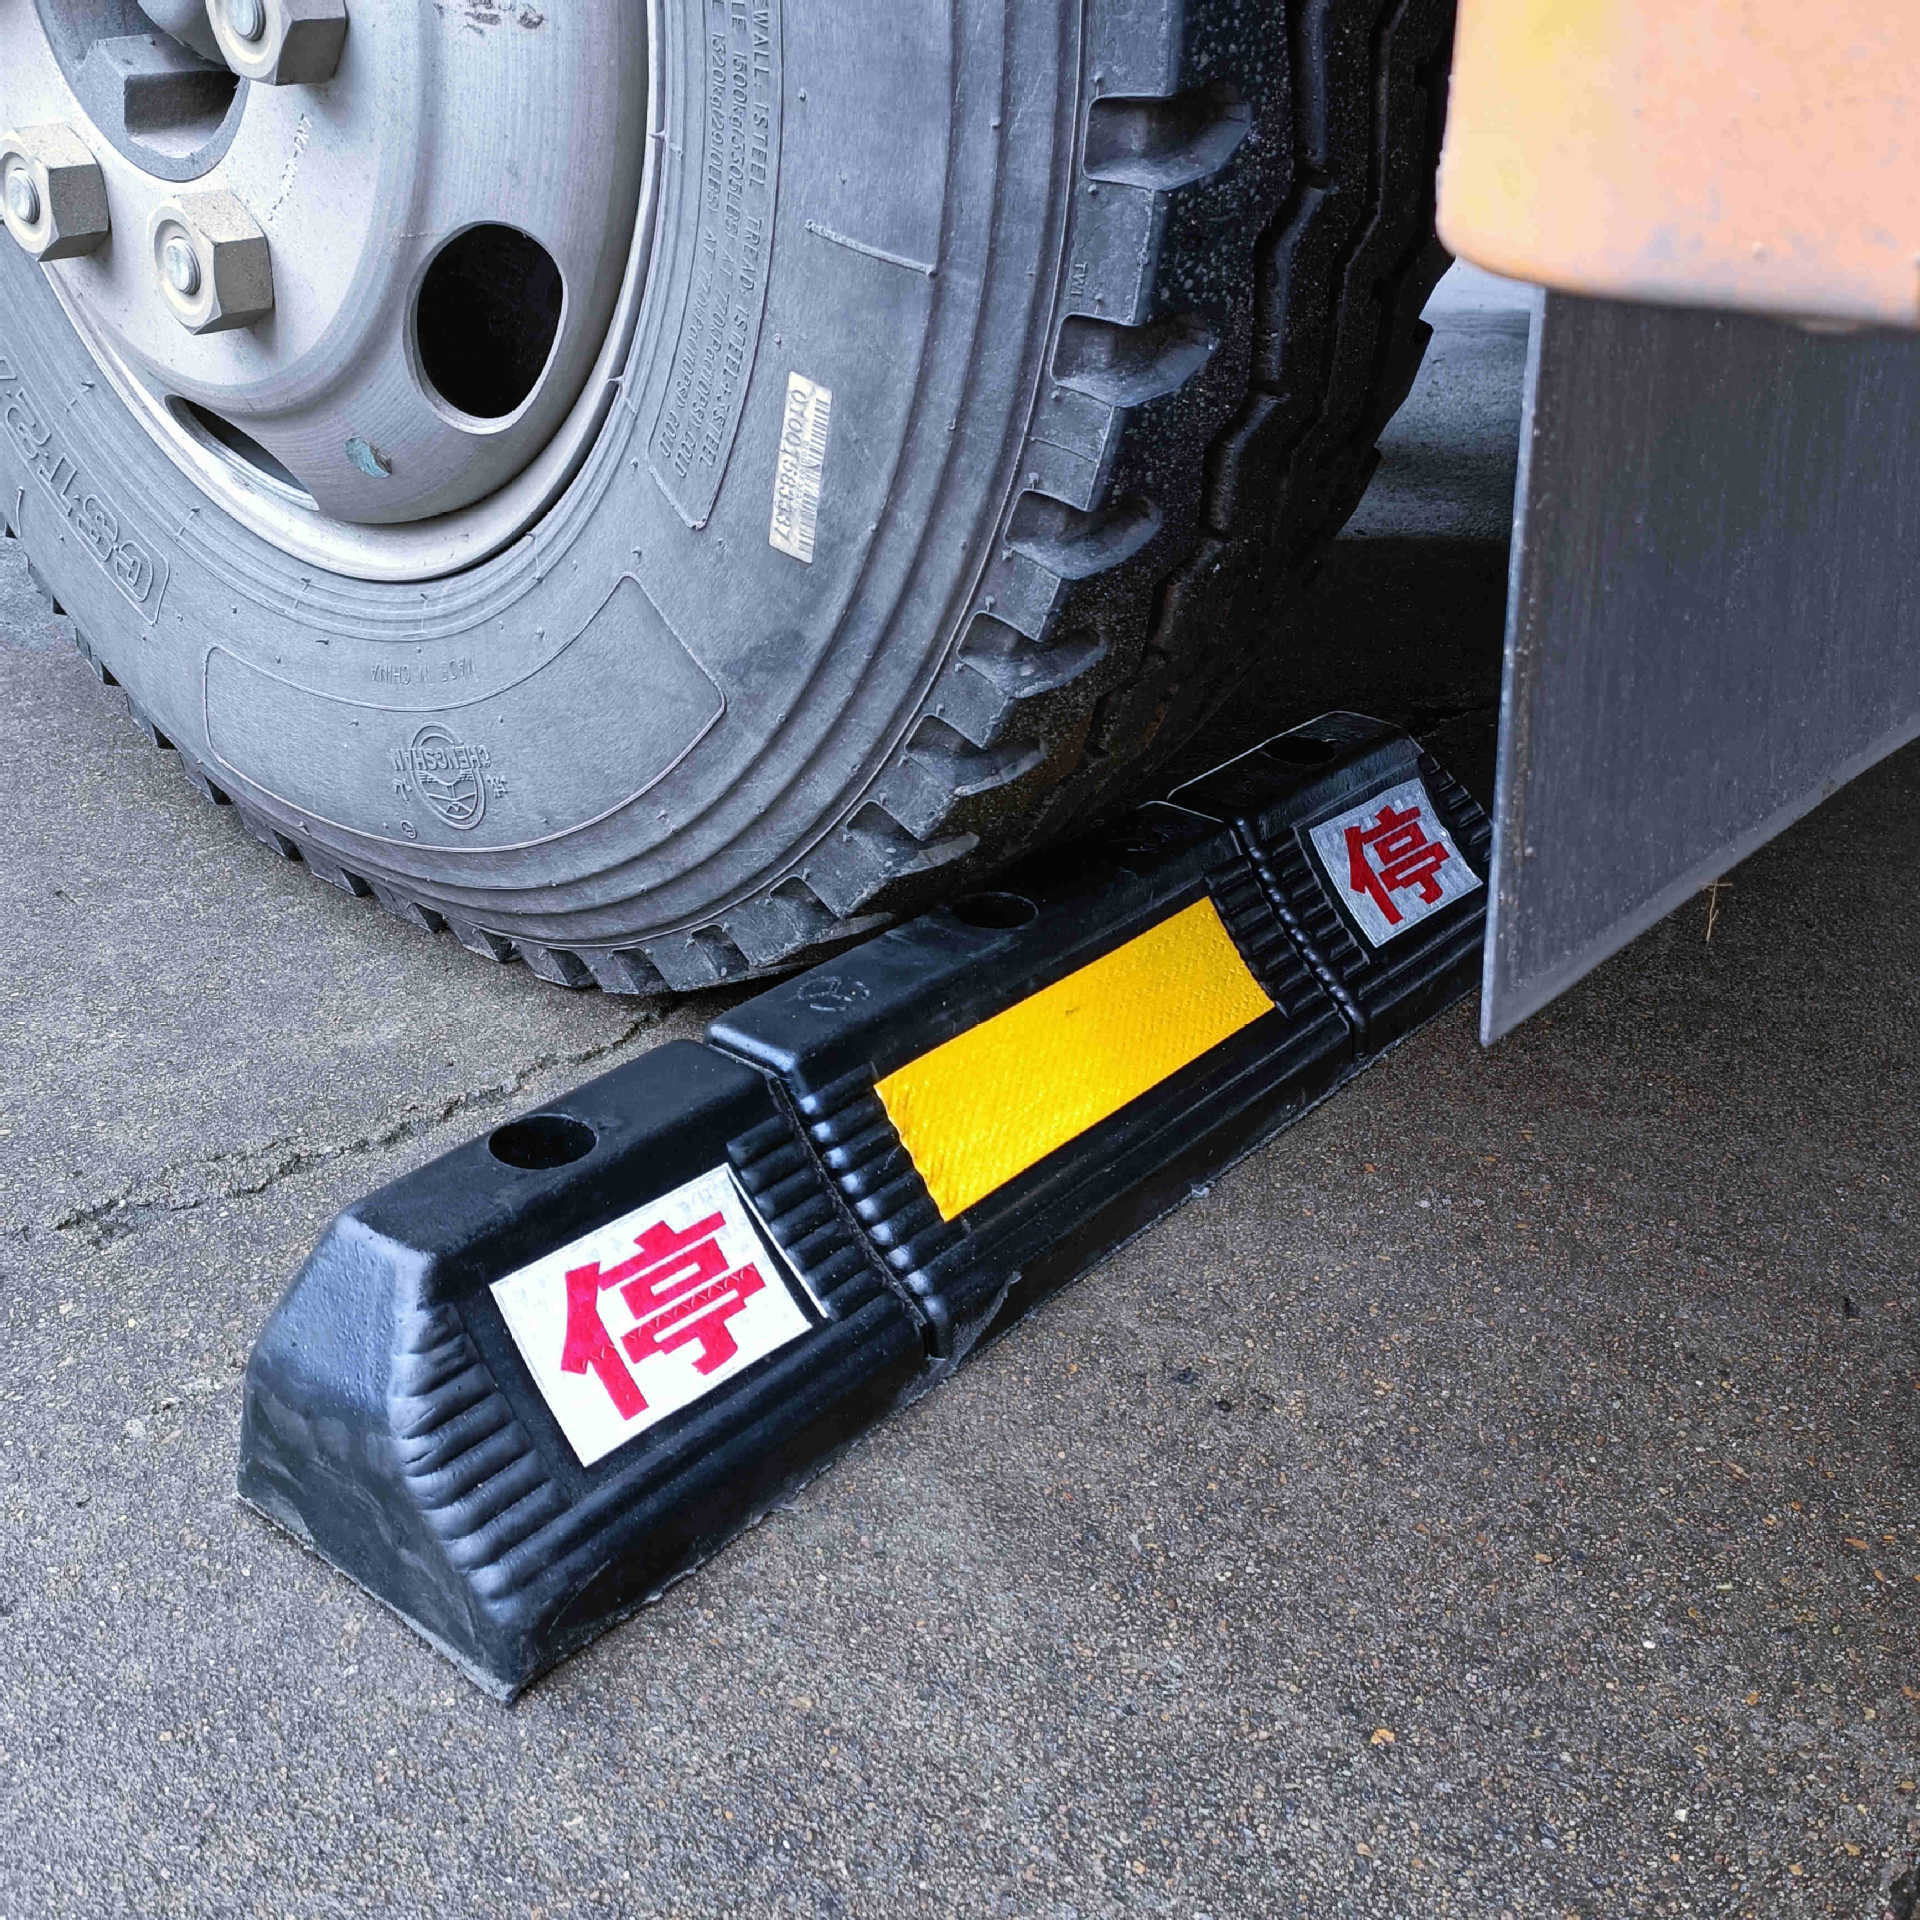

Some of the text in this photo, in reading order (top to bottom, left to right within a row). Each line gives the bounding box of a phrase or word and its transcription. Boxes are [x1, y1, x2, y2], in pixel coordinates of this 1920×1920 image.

[1070, 262, 1088, 296] TWI
[371, 663, 412, 686] CHINA
[387, 743, 492, 772] CHENGSHAN
[1344, 805, 1449, 924] 停
[560, 1211, 766, 1420] 停
